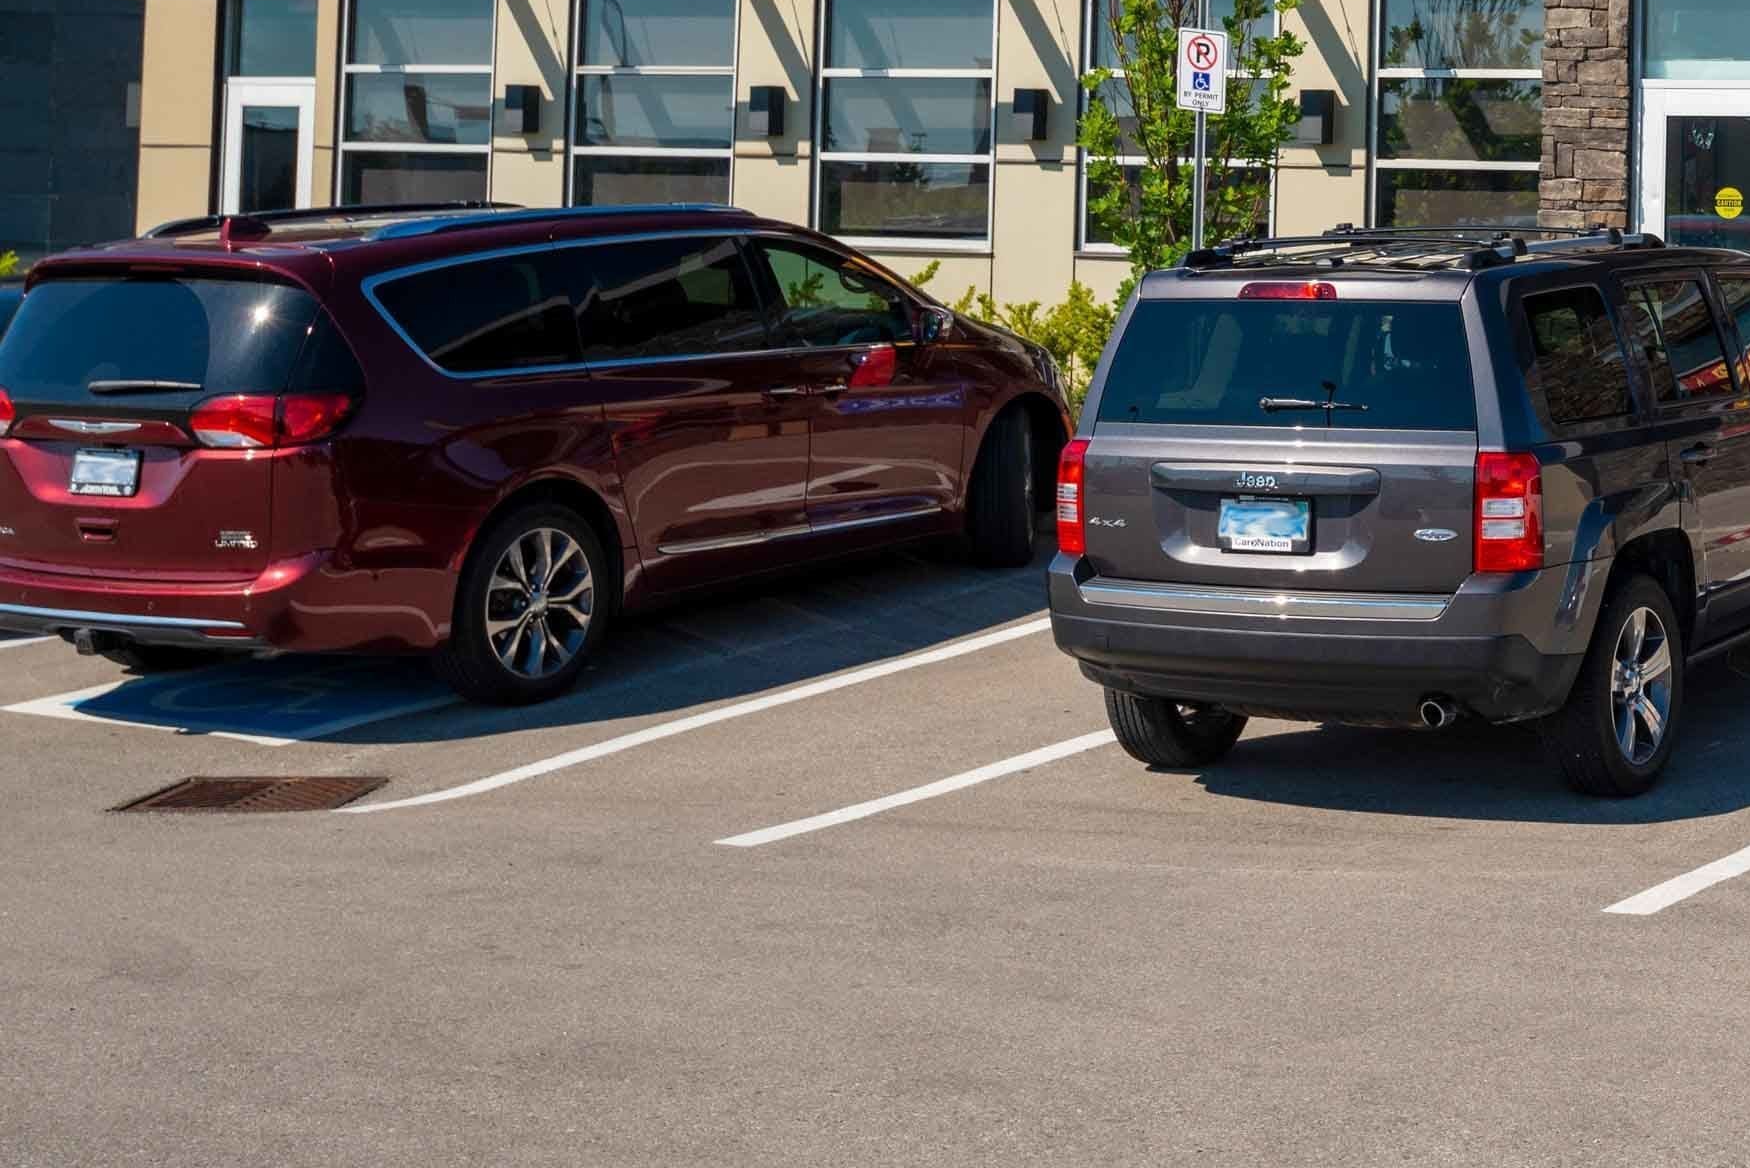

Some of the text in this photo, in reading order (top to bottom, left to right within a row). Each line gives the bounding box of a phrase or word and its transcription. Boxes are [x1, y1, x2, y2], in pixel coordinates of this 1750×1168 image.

[1194, 93, 1219, 101] PERMIT
[1192, 99, 1209, 107] ONLY
[1716, 199, 1742, 208] CAUTION
[1235, 472, 1279, 490] Jeep
